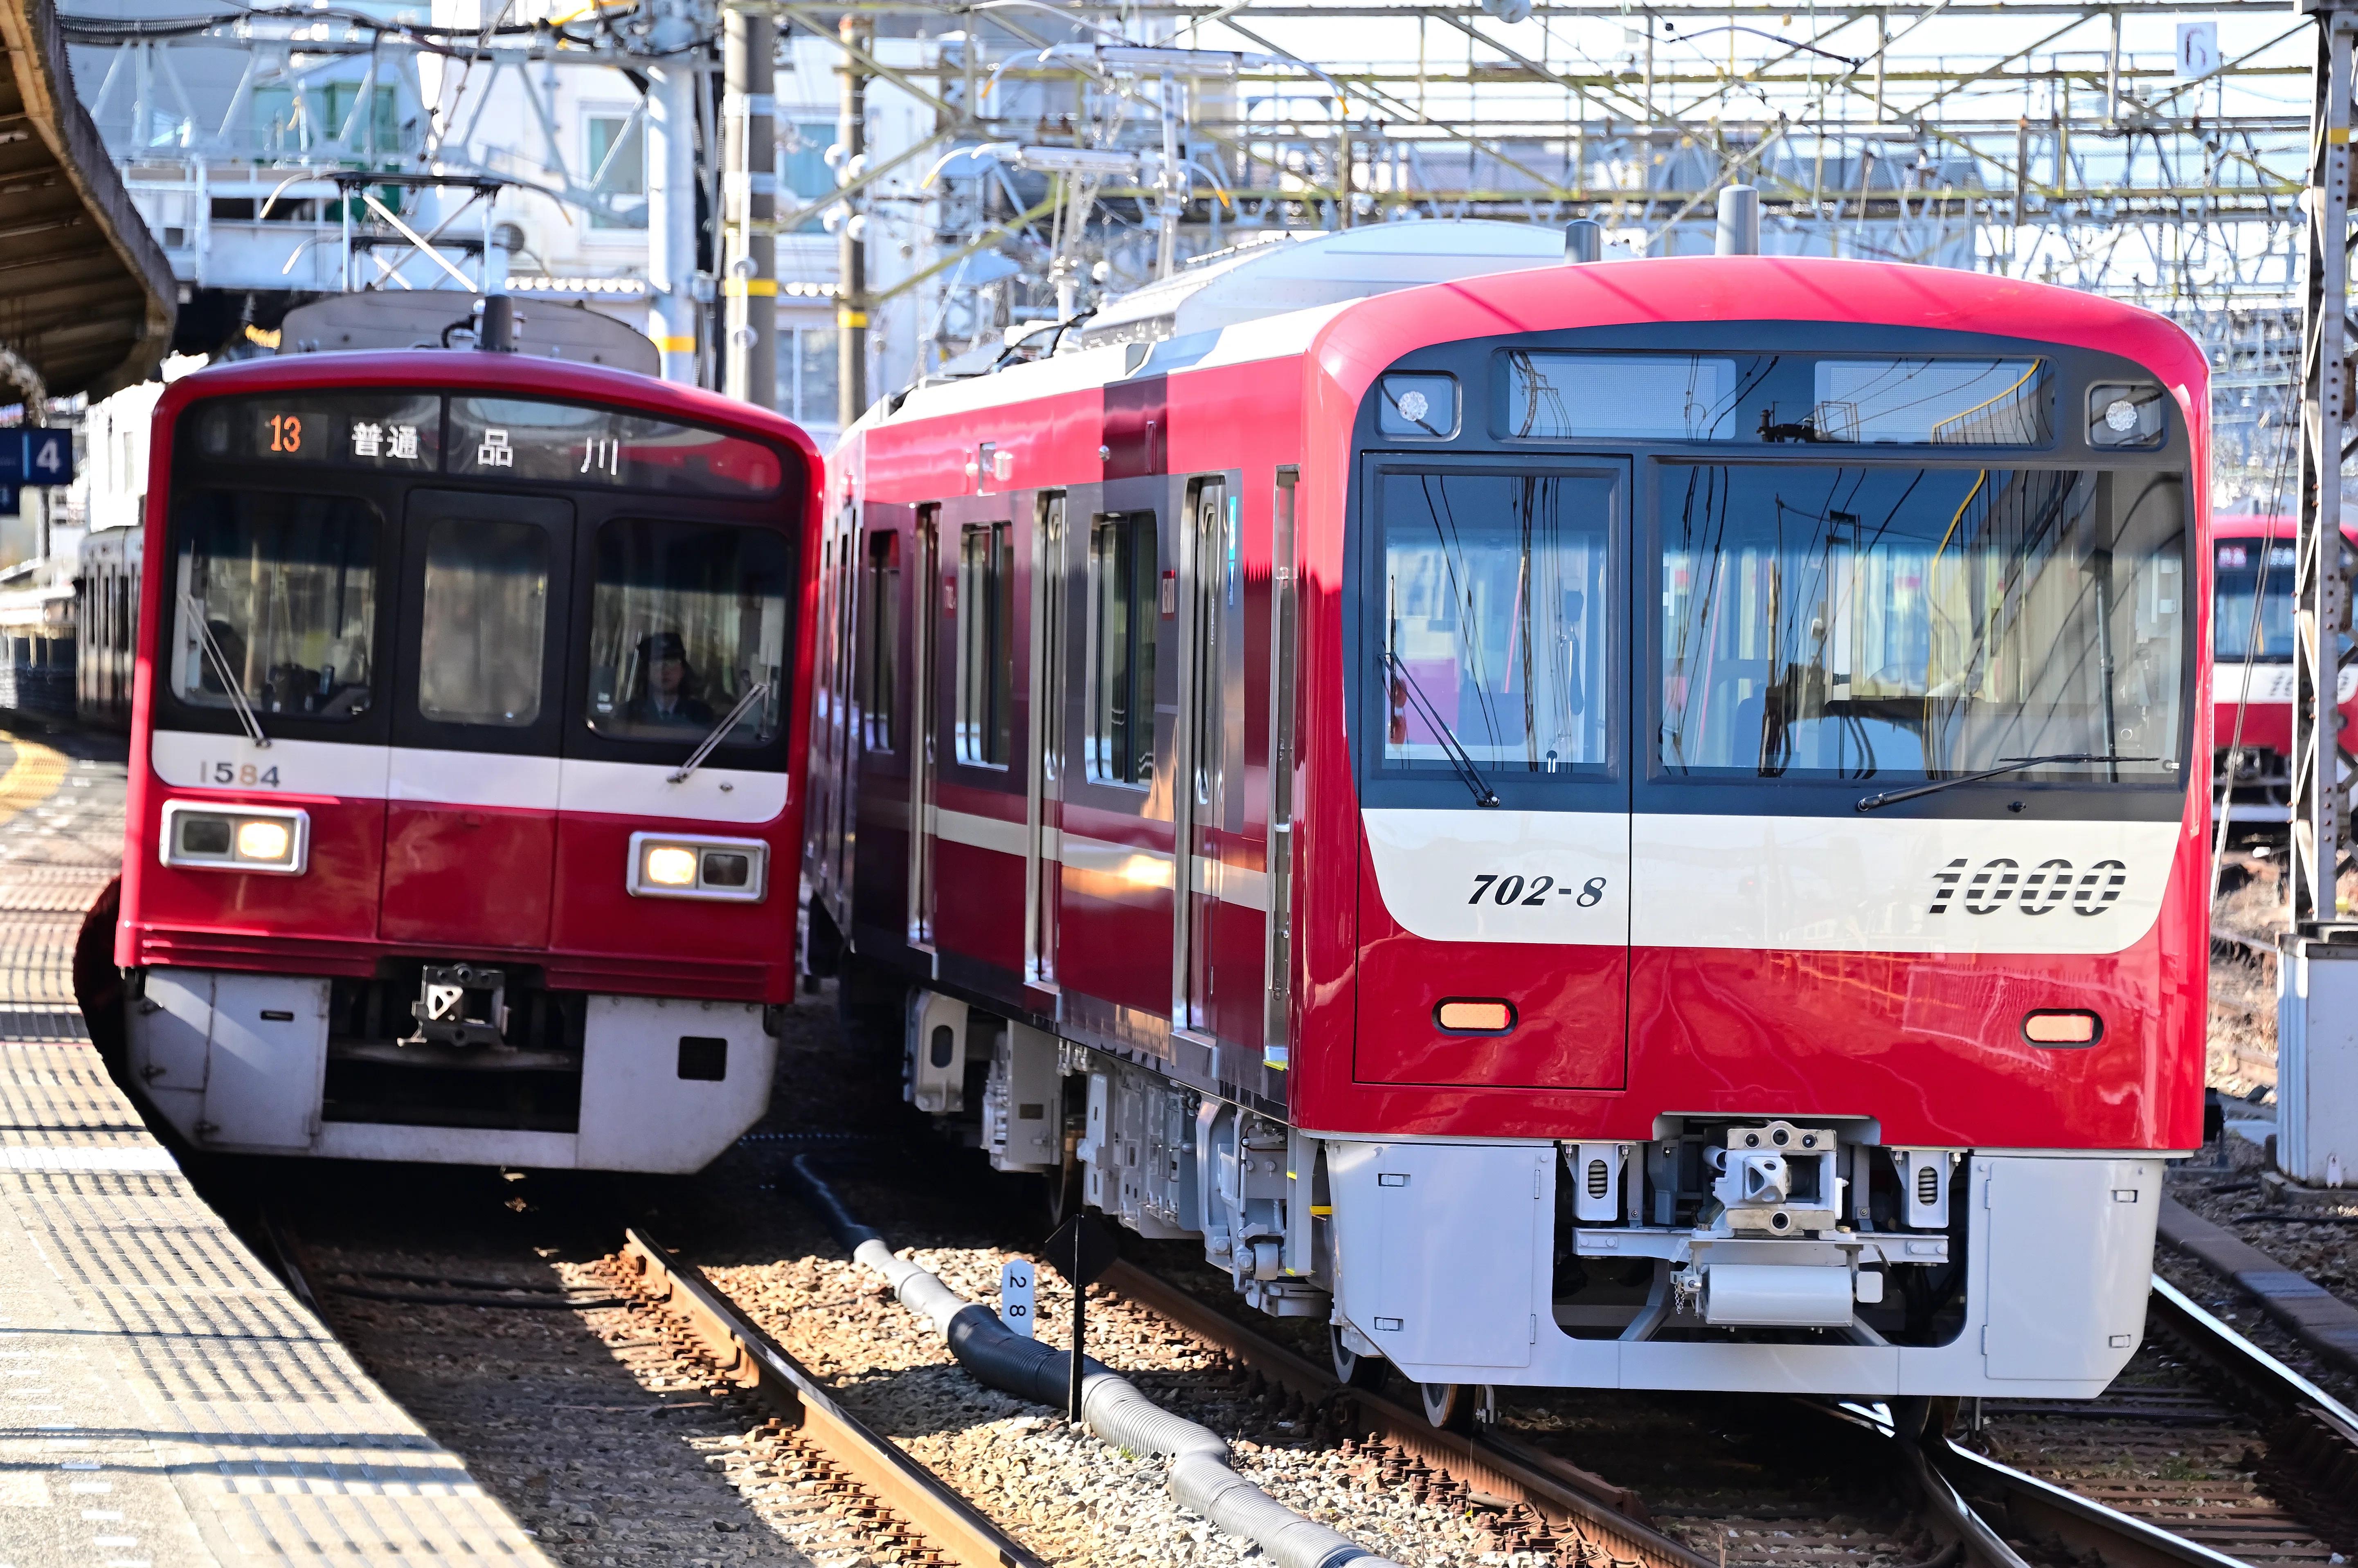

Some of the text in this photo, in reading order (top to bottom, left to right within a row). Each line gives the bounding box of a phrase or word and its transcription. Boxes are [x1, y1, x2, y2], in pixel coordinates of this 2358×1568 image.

[270, 414, 302, 452] 13
[351, 422, 619, 476] 普通 品川
[36, 438, 61, 474] 4
[200, 761, 280, 788] 1584
[1468, 874, 1606, 908] 702-8
[1928, 858, 2126, 916] 1000
